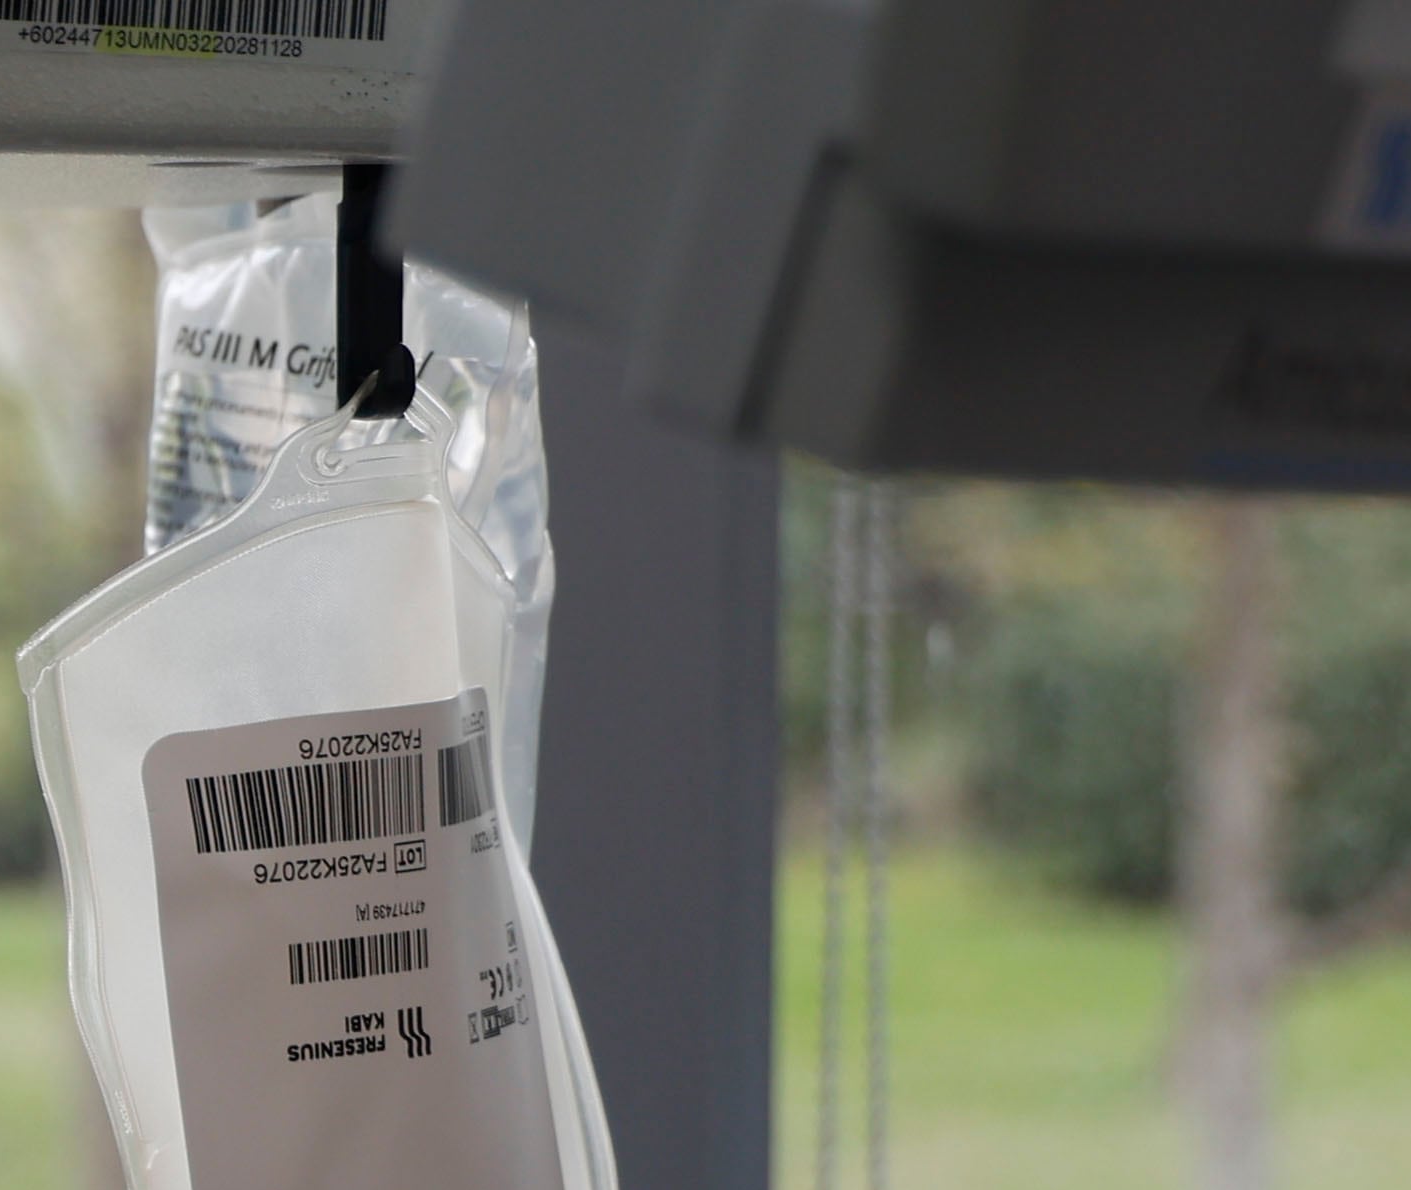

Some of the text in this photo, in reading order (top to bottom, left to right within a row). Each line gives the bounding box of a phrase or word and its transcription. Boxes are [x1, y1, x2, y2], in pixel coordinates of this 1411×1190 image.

[18, 25, 302, 58] +60244713UMN03220281128
[248, 337, 278, 369] M
[298, 727, 422, 760] FA25K22076
[253, 851, 387, 885] FA25K22076
[345, 1012, 386, 1034] KABI
[286, 1035, 386, 1062] FRESENIUS
